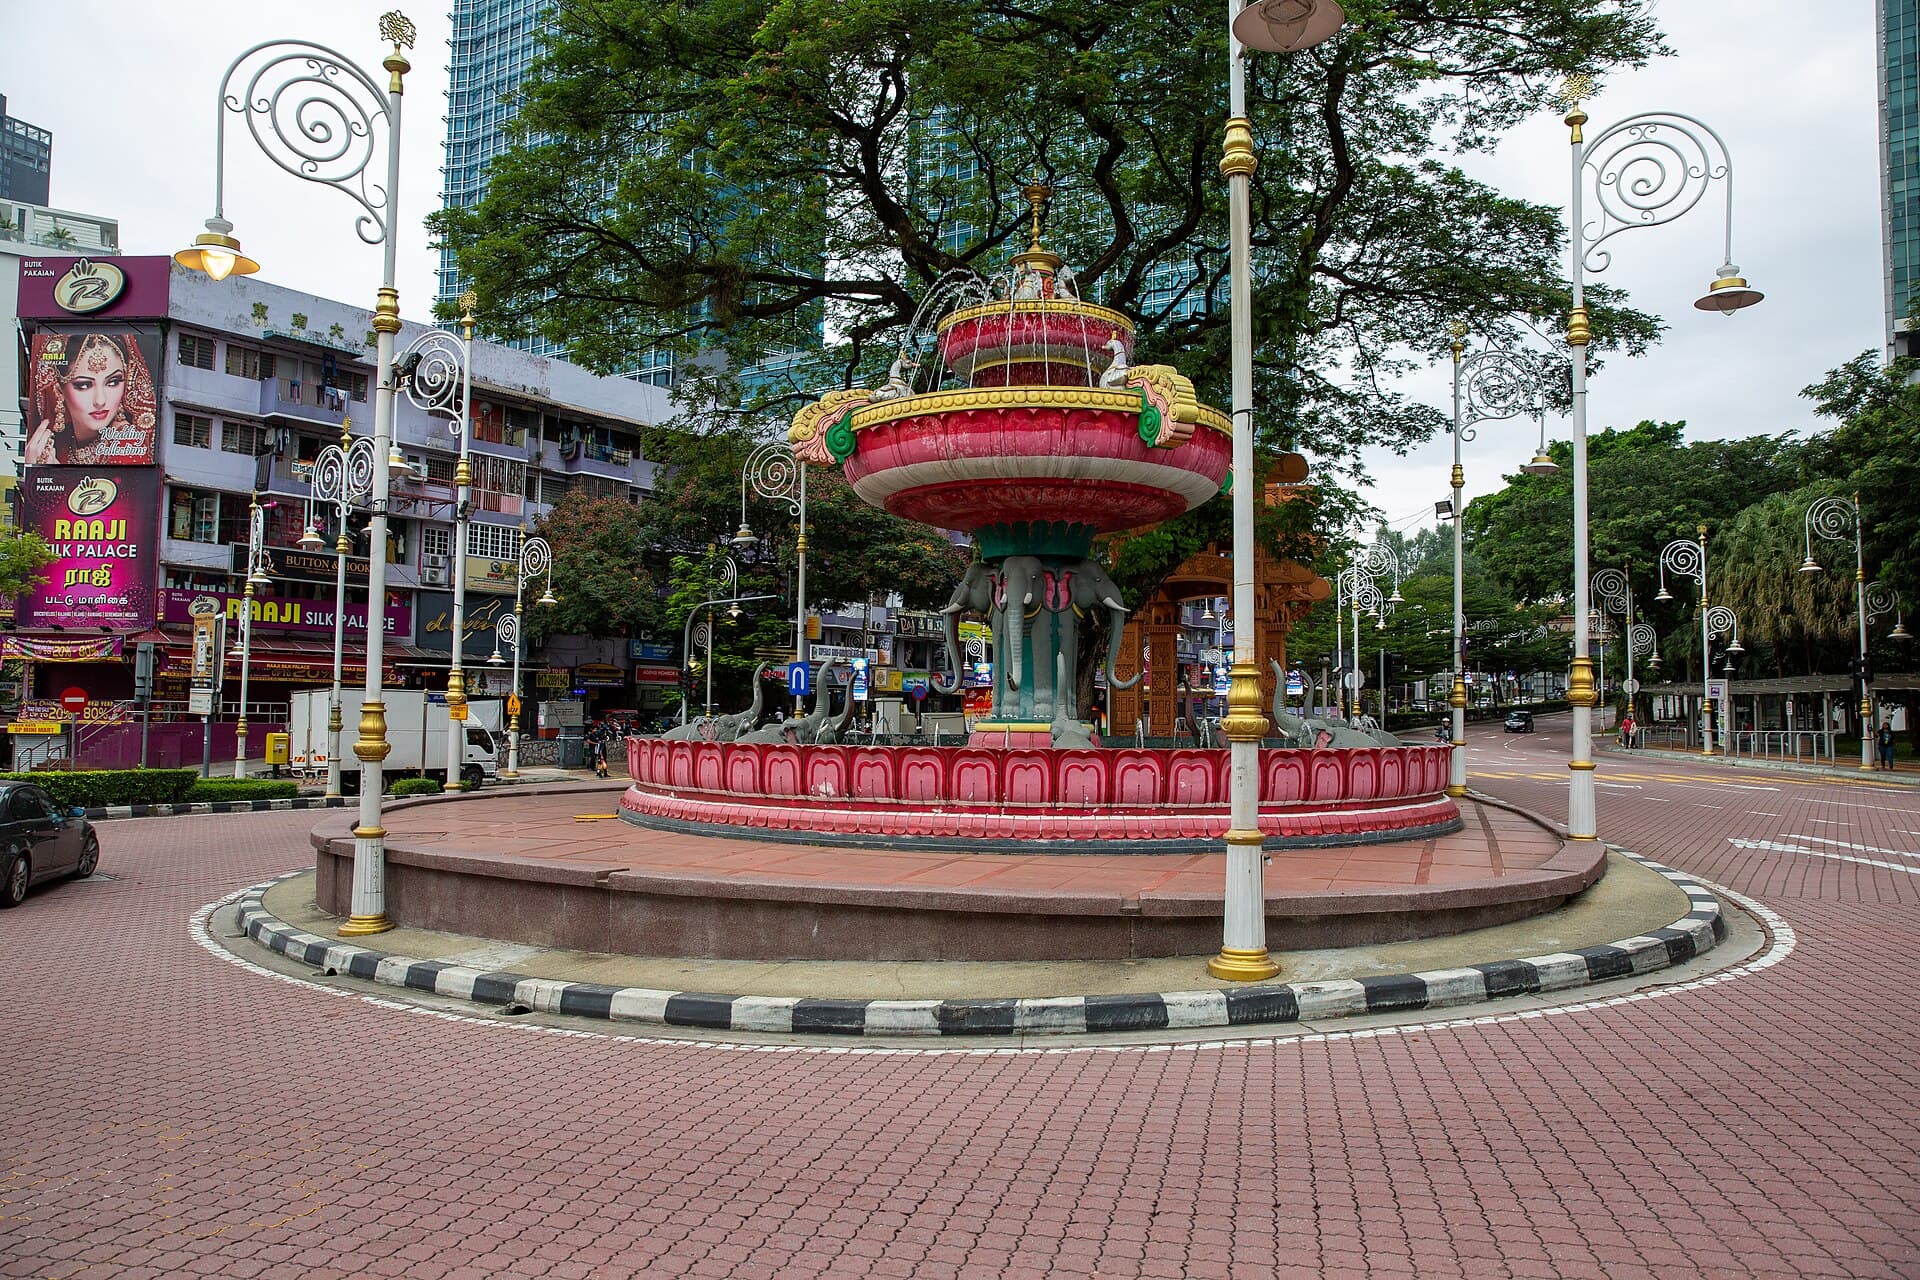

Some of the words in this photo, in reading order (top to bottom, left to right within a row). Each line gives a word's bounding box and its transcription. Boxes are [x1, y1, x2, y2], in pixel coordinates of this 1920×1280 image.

[99, 424, 147, 447] Wedding
[95, 441, 148, 456] Collections
[54, 519, 127, 541] RAAJI
[76, 543, 137, 558] PALACE
[286, 555, 329, 569] BUTTON
[63, 562, 114, 590] ராஜி
[45, 593, 74, 606] பட்டு
[78, 593, 129, 606] மாளிகை
[226, 598, 301, 624] RAAJI
[305, 611, 334, 626] SILK
[48, 707, 73, 720] 20%
[83, 707, 108, 720] 80%
